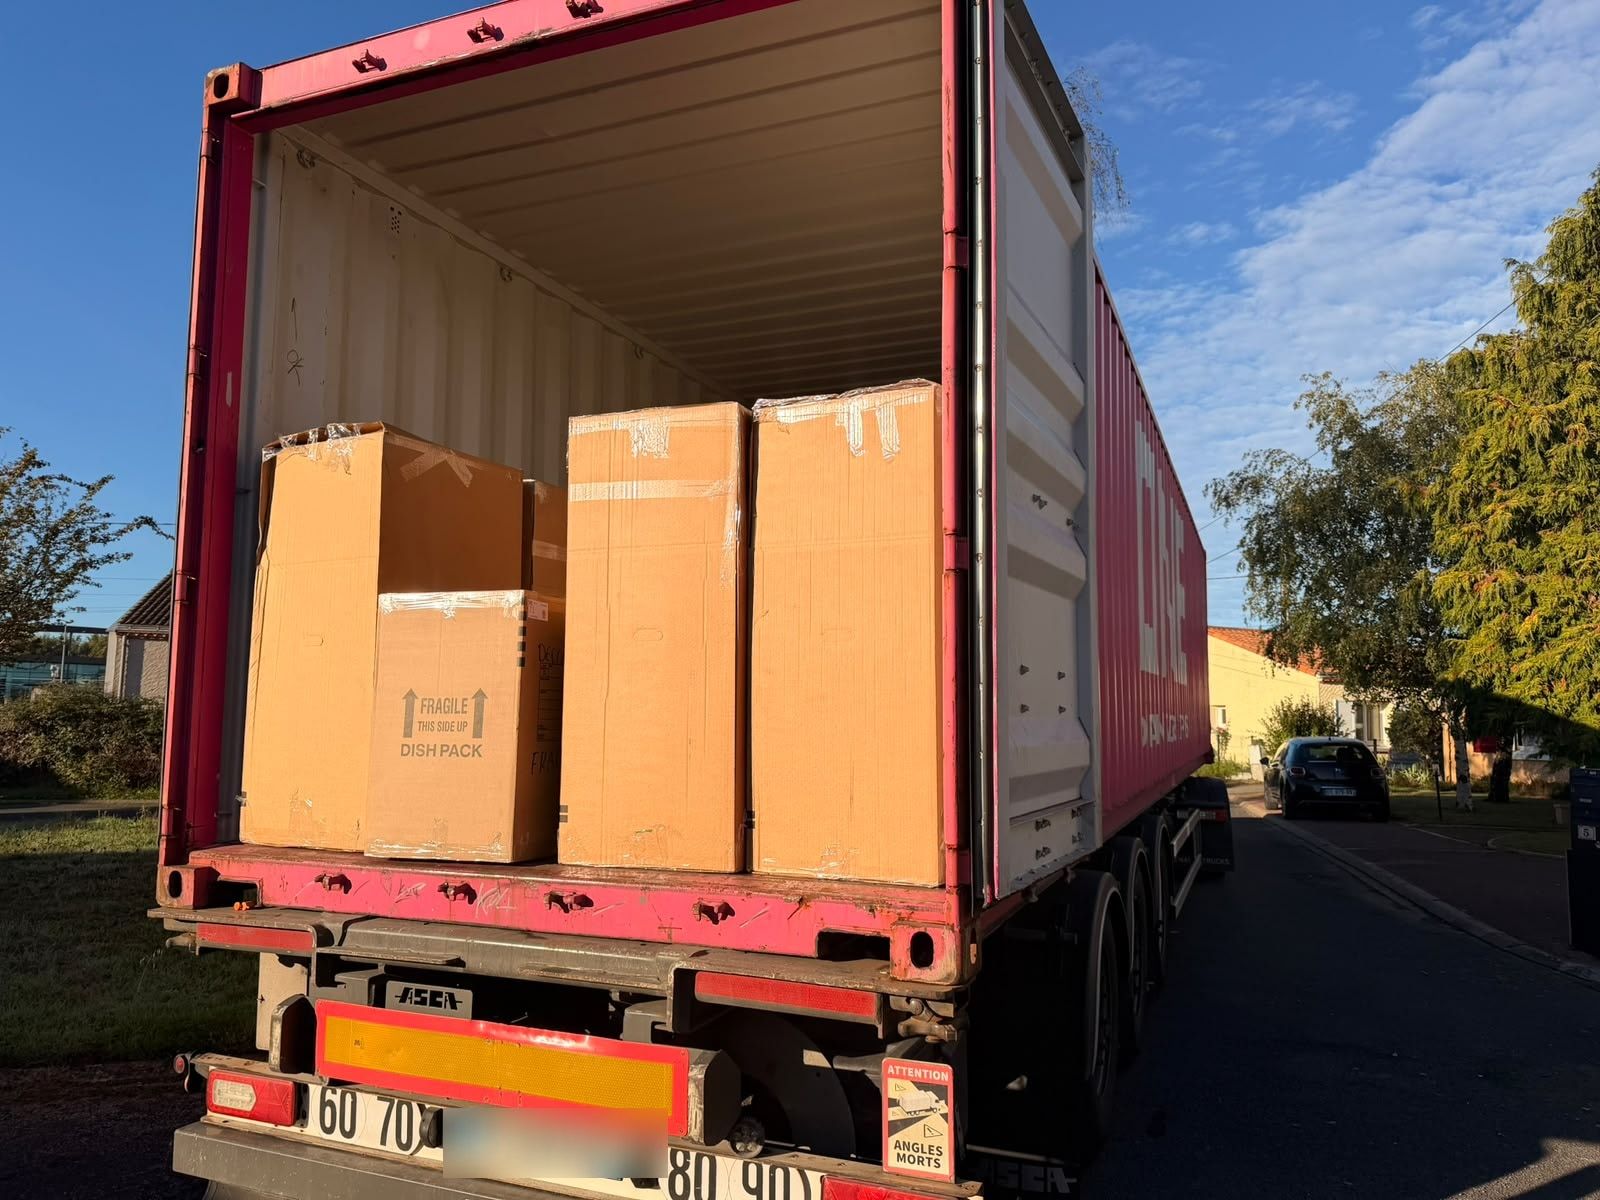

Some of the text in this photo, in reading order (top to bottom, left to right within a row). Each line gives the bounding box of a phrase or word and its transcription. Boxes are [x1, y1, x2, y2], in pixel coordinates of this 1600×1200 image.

[420, 697, 469, 714] FRAGILE
[417, 720, 468, 732] THIS SIDE UP
[400, 743, 483, 758] DISH PACK
[887, 1064, 949, 1081] ATTENTION
[319, 1086, 413, 1152] 60 70
[894, 1139, 943, 1157] ANGLES
[896, 1151, 942, 1169] MORTS
[668, 1148, 791, 1200] 80 90
